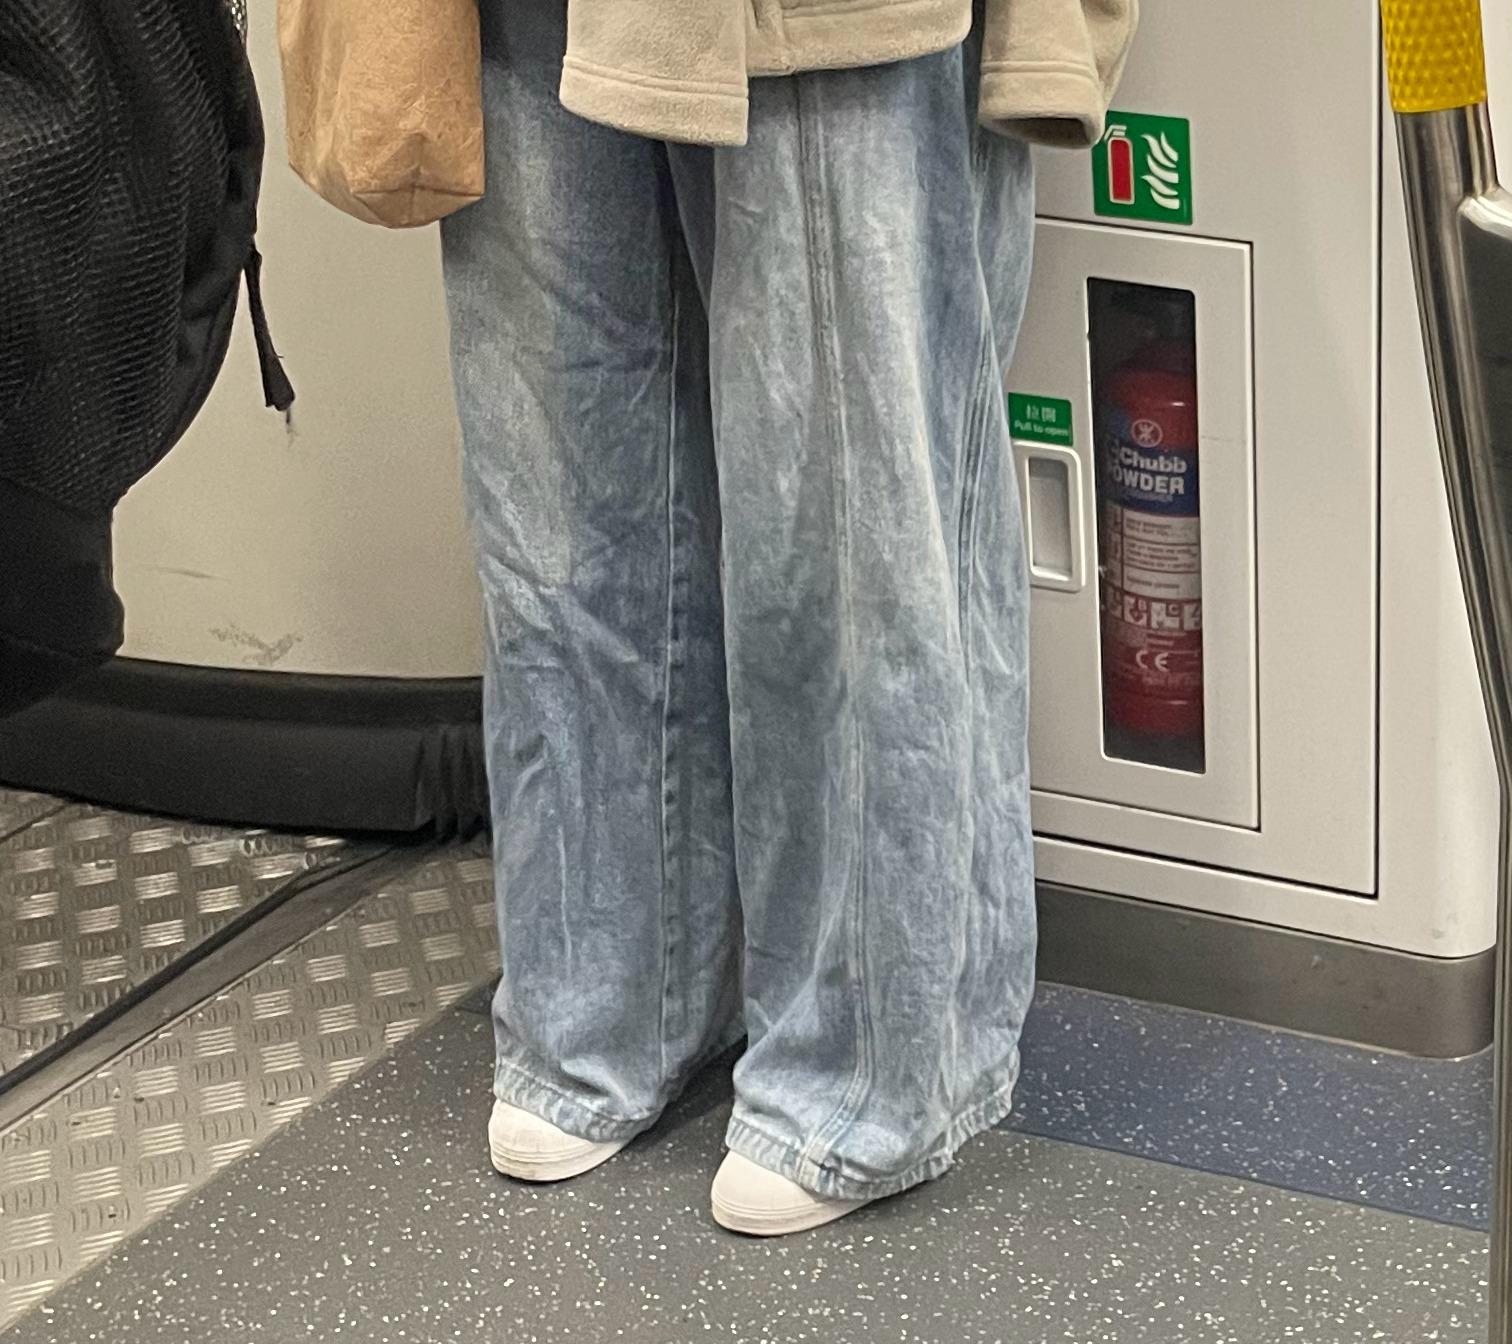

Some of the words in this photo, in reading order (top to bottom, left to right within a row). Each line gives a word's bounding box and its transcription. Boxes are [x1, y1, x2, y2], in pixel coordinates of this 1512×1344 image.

[1014, 419, 1032, 431] Pull
[1033, 424, 1044, 433] to
[1045, 427, 1068, 437] open
[1120, 446, 1188, 474] Chubb
